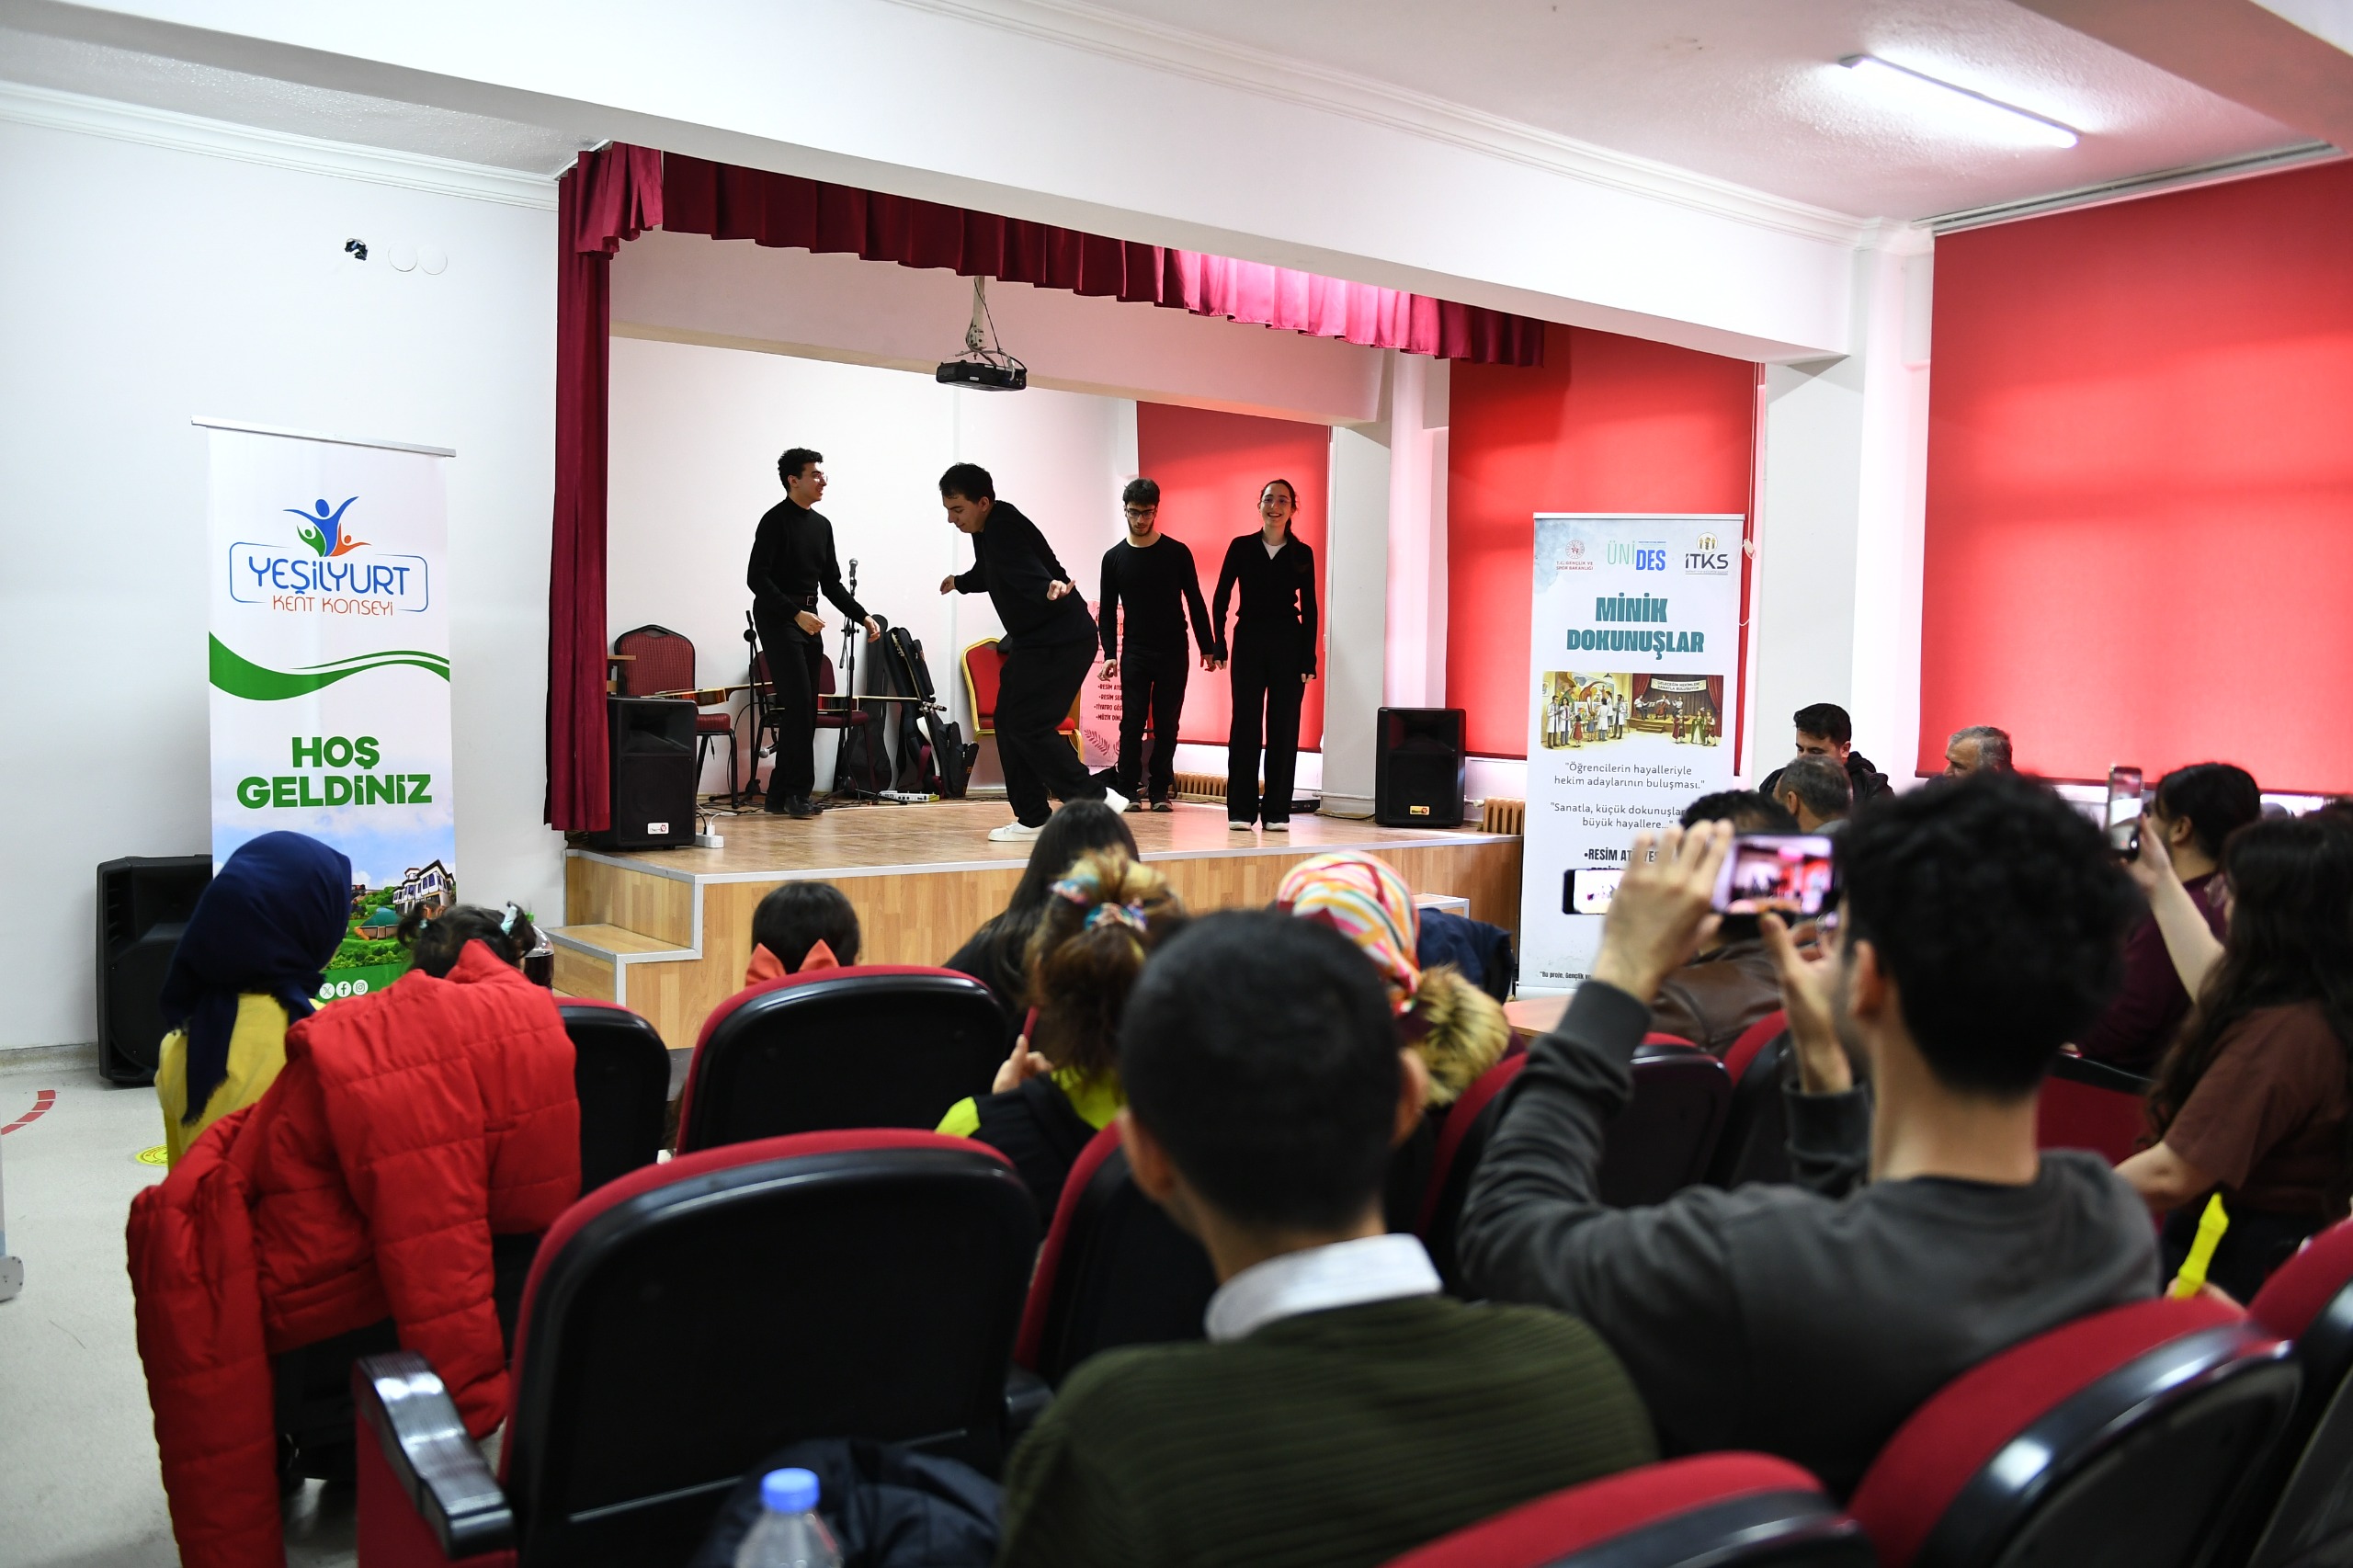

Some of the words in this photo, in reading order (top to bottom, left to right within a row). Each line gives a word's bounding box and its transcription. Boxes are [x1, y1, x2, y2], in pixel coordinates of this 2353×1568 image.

[1685, 553, 1729, 570] İTKS
[248, 556, 411, 596] YEŞİLYURT
[273, 595, 315, 612] KENT
[322, 597, 393, 616] KONSEYİ
[1596, 592, 1668, 623] MİNİK
[1566, 629, 1705, 660] DOKUNUŞLAR
[291, 736, 381, 770] HOŞ
[1564, 761, 1631, 775] "Öğrencilerin
[1633, 764, 1692, 777] hayalleriyle
[236, 774, 433, 810] GELDİNİZ
[1554, 775, 1585, 786] hekim
[1586, 777, 1643, 789] adaylarının
[1646, 778, 1705, 790] buluşması."
[1550, 801, 1594, 814] "Sanatla,
[1596, 803, 1626, 815] küçük
[1628, 804, 1686, 818] dokunuşlar
[1582, 817, 1613, 829] büyük
